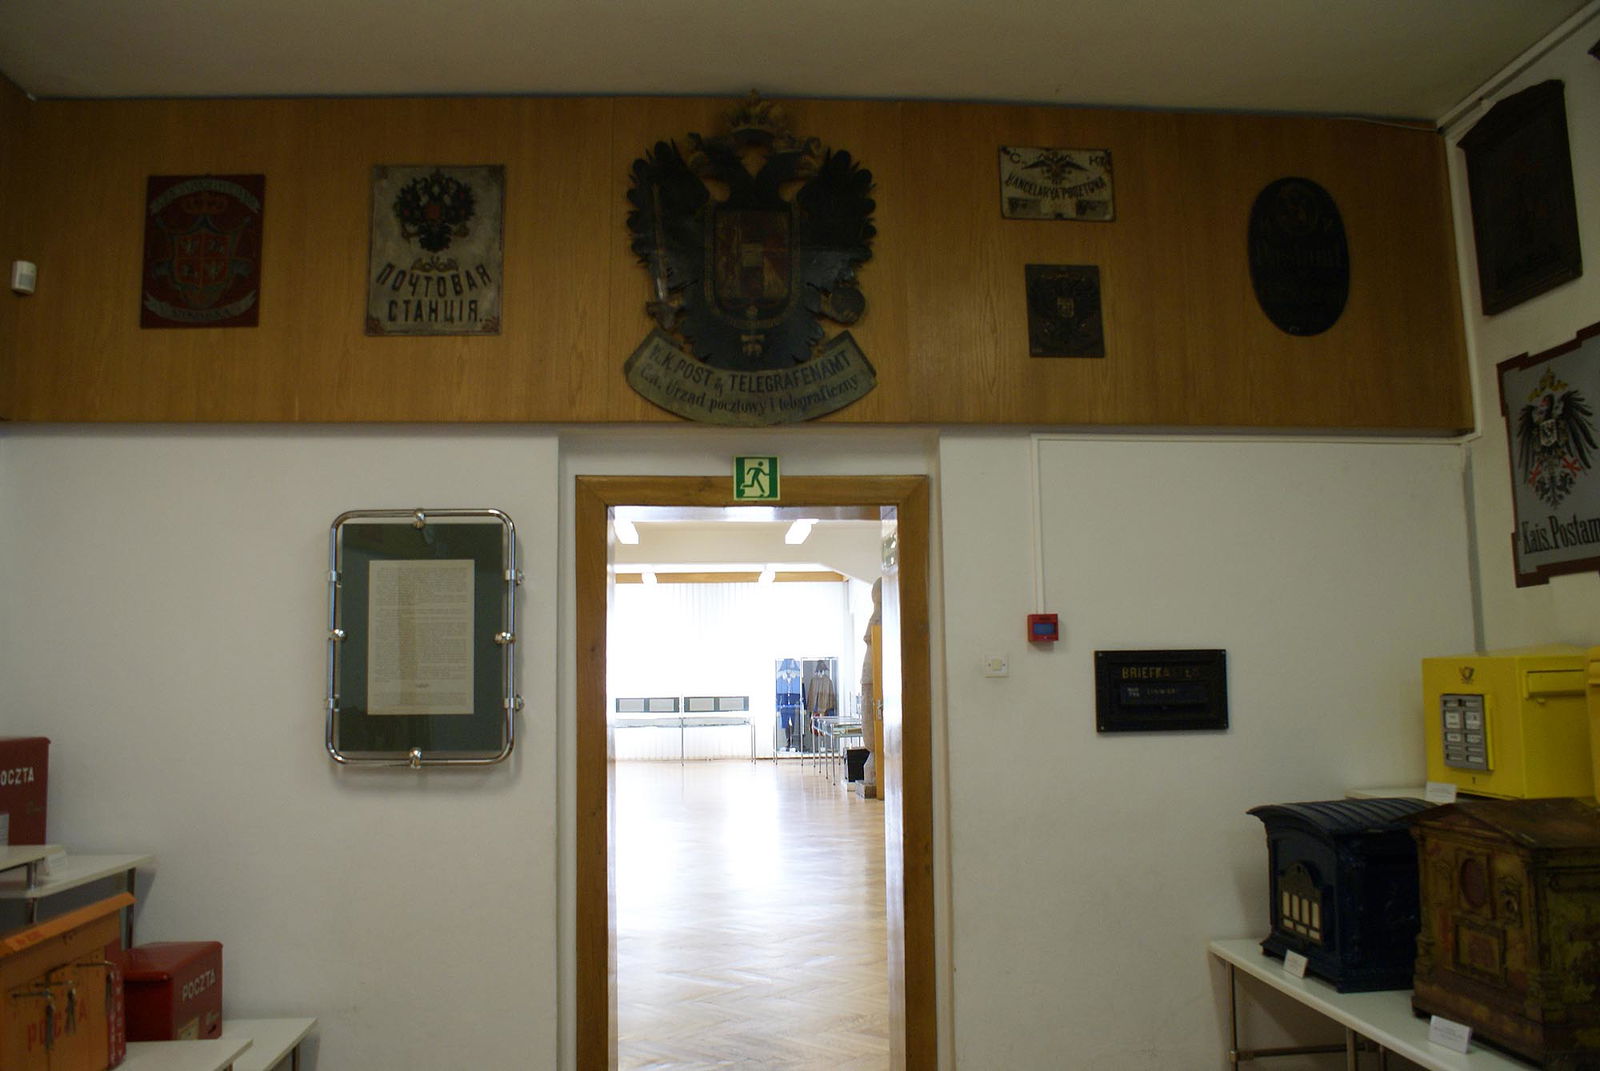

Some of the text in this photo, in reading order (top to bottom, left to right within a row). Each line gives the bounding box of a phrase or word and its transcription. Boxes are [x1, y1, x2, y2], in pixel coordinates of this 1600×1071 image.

[376, 262, 492, 297] ПОЧТОВАЯ
[674, 359, 714, 387] POST
[730, 350, 850, 393] TELEGRAFENAMT
[709, 398, 766, 417] pocztowy
[1521, 520, 1554, 555] Kais.
[183, 968, 216, 1003] POCZTA
